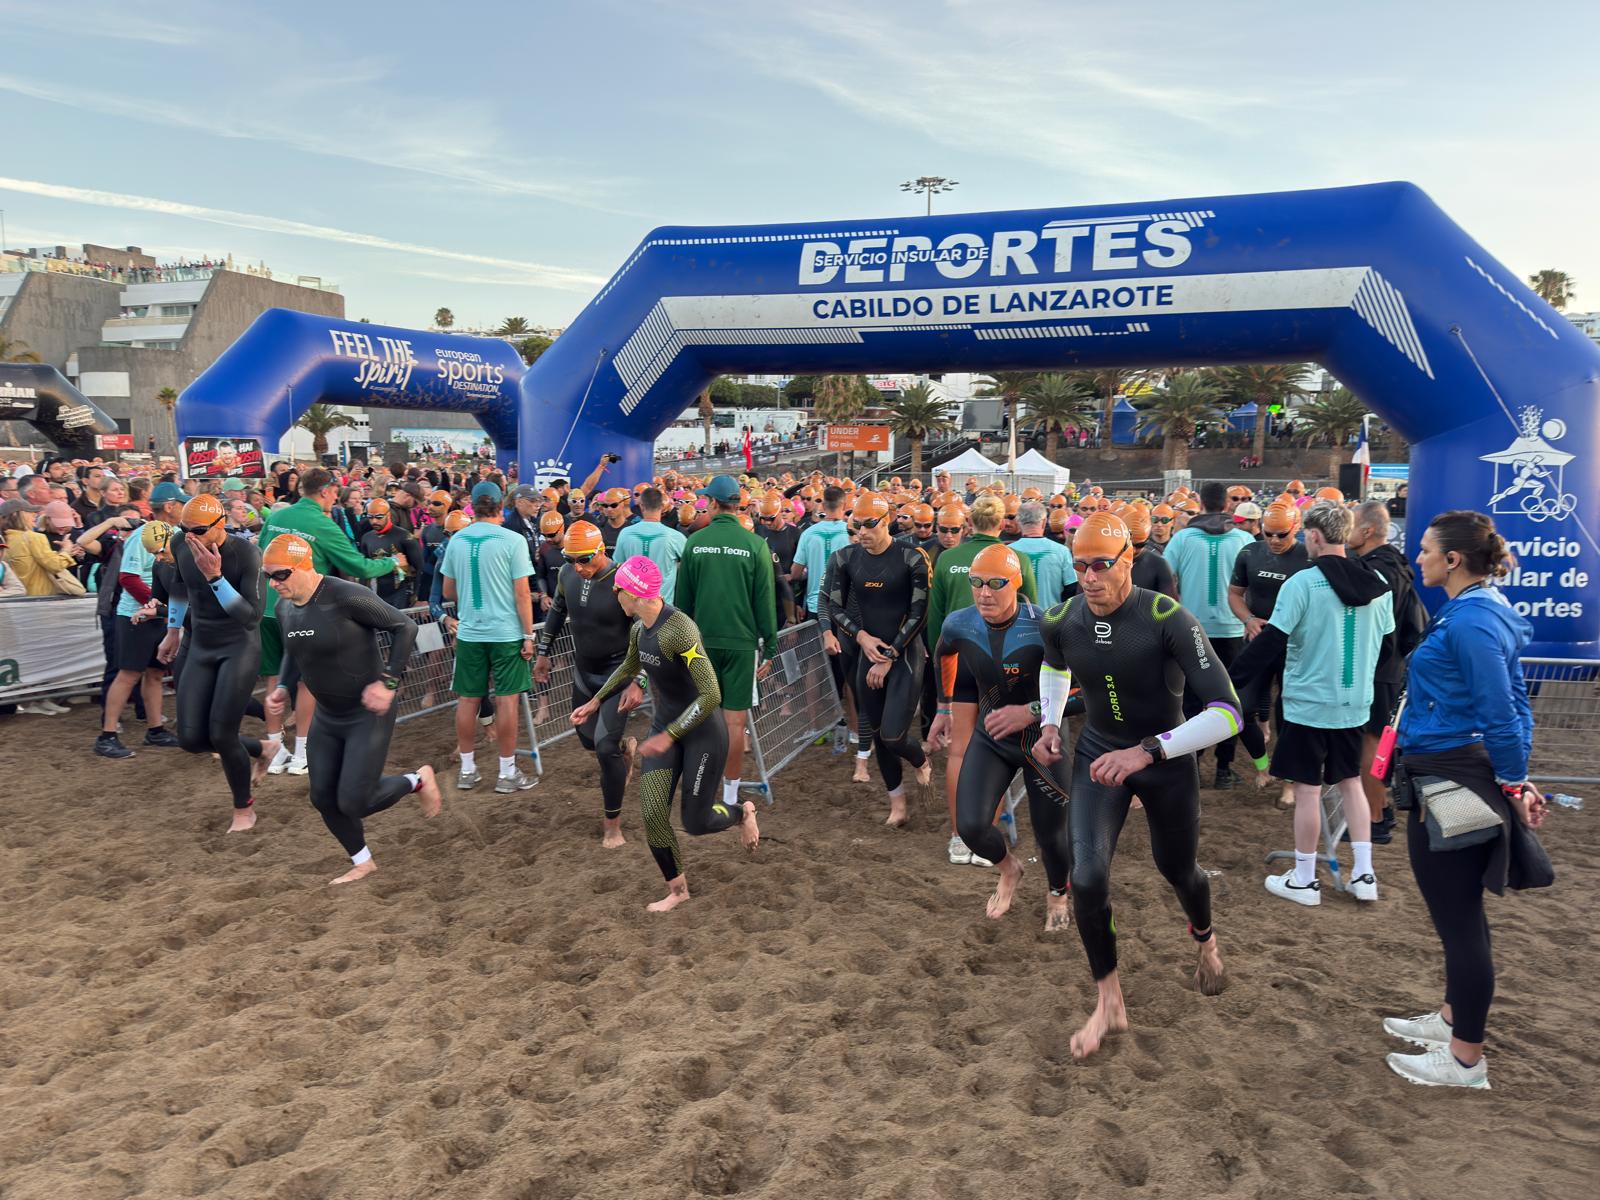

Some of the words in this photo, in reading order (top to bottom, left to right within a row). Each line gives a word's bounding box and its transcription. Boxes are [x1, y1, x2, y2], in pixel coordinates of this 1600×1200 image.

[799, 220, 1192, 286] DEPORTES
[814, 252, 887, 267] SERVICIO
[891, 248, 961, 264] INSULAR
[966, 247, 989, 260] DE
[813, 296, 933, 319] CABILDO
[943, 294, 980, 316] DE
[990, 284, 1174, 313] LANZAROTE
[329, 329, 379, 361] FEEL
[377, 336, 414, 368] THE
[435, 348, 482, 362] european
[353, 359, 419, 390] spirit
[437, 358, 504, 385] sports
[453, 380, 500, 393] DESTINATION
[830, 427, 859, 435] UNDER
[692, 546, 721, 554] Green
[722, 546, 750, 558] Team
[1505, 536, 1581, 557] rvicio
[1487, 567, 1553, 587] ular
[1560, 567, 1589, 587] de
[1512, 597, 1583, 618] ortes
[287, 629, 315, 638] orca
[1003, 667, 1020, 675] 70
[1104, 674, 1115, 690] 3.0
[1109, 690, 1124, 722] FJORD
[1033, 777, 1070, 807] HELIX
